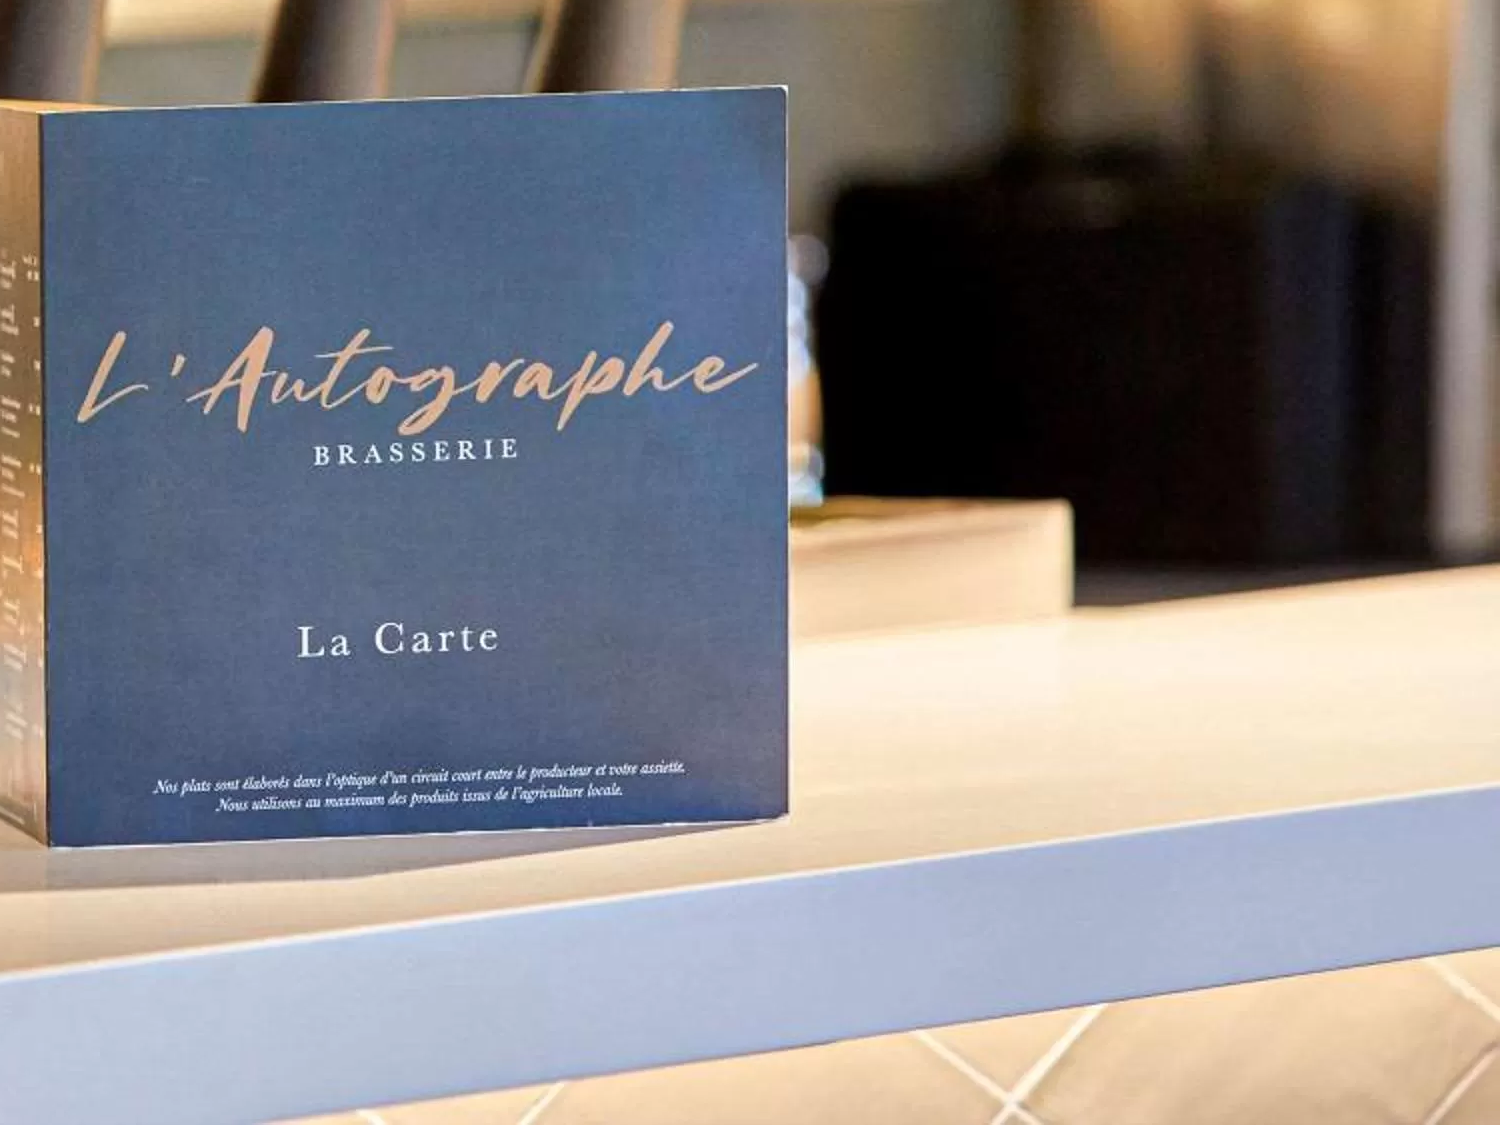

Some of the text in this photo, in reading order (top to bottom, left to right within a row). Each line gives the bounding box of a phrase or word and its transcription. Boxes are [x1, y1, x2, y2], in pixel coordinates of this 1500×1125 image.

[76, 321, 759, 435] L'Autographe
[313, 438, 518, 467] BRASSERIE
[296, 622, 499, 658] La Carte
[152, 759, 685, 797] Nos plats sont élaborés dans l'optique d'un circuit court entre le producteur et votre assiette.
[215, 783, 623, 812] Nous utilisons au maximum des produits issus de l'agriculture locale.
